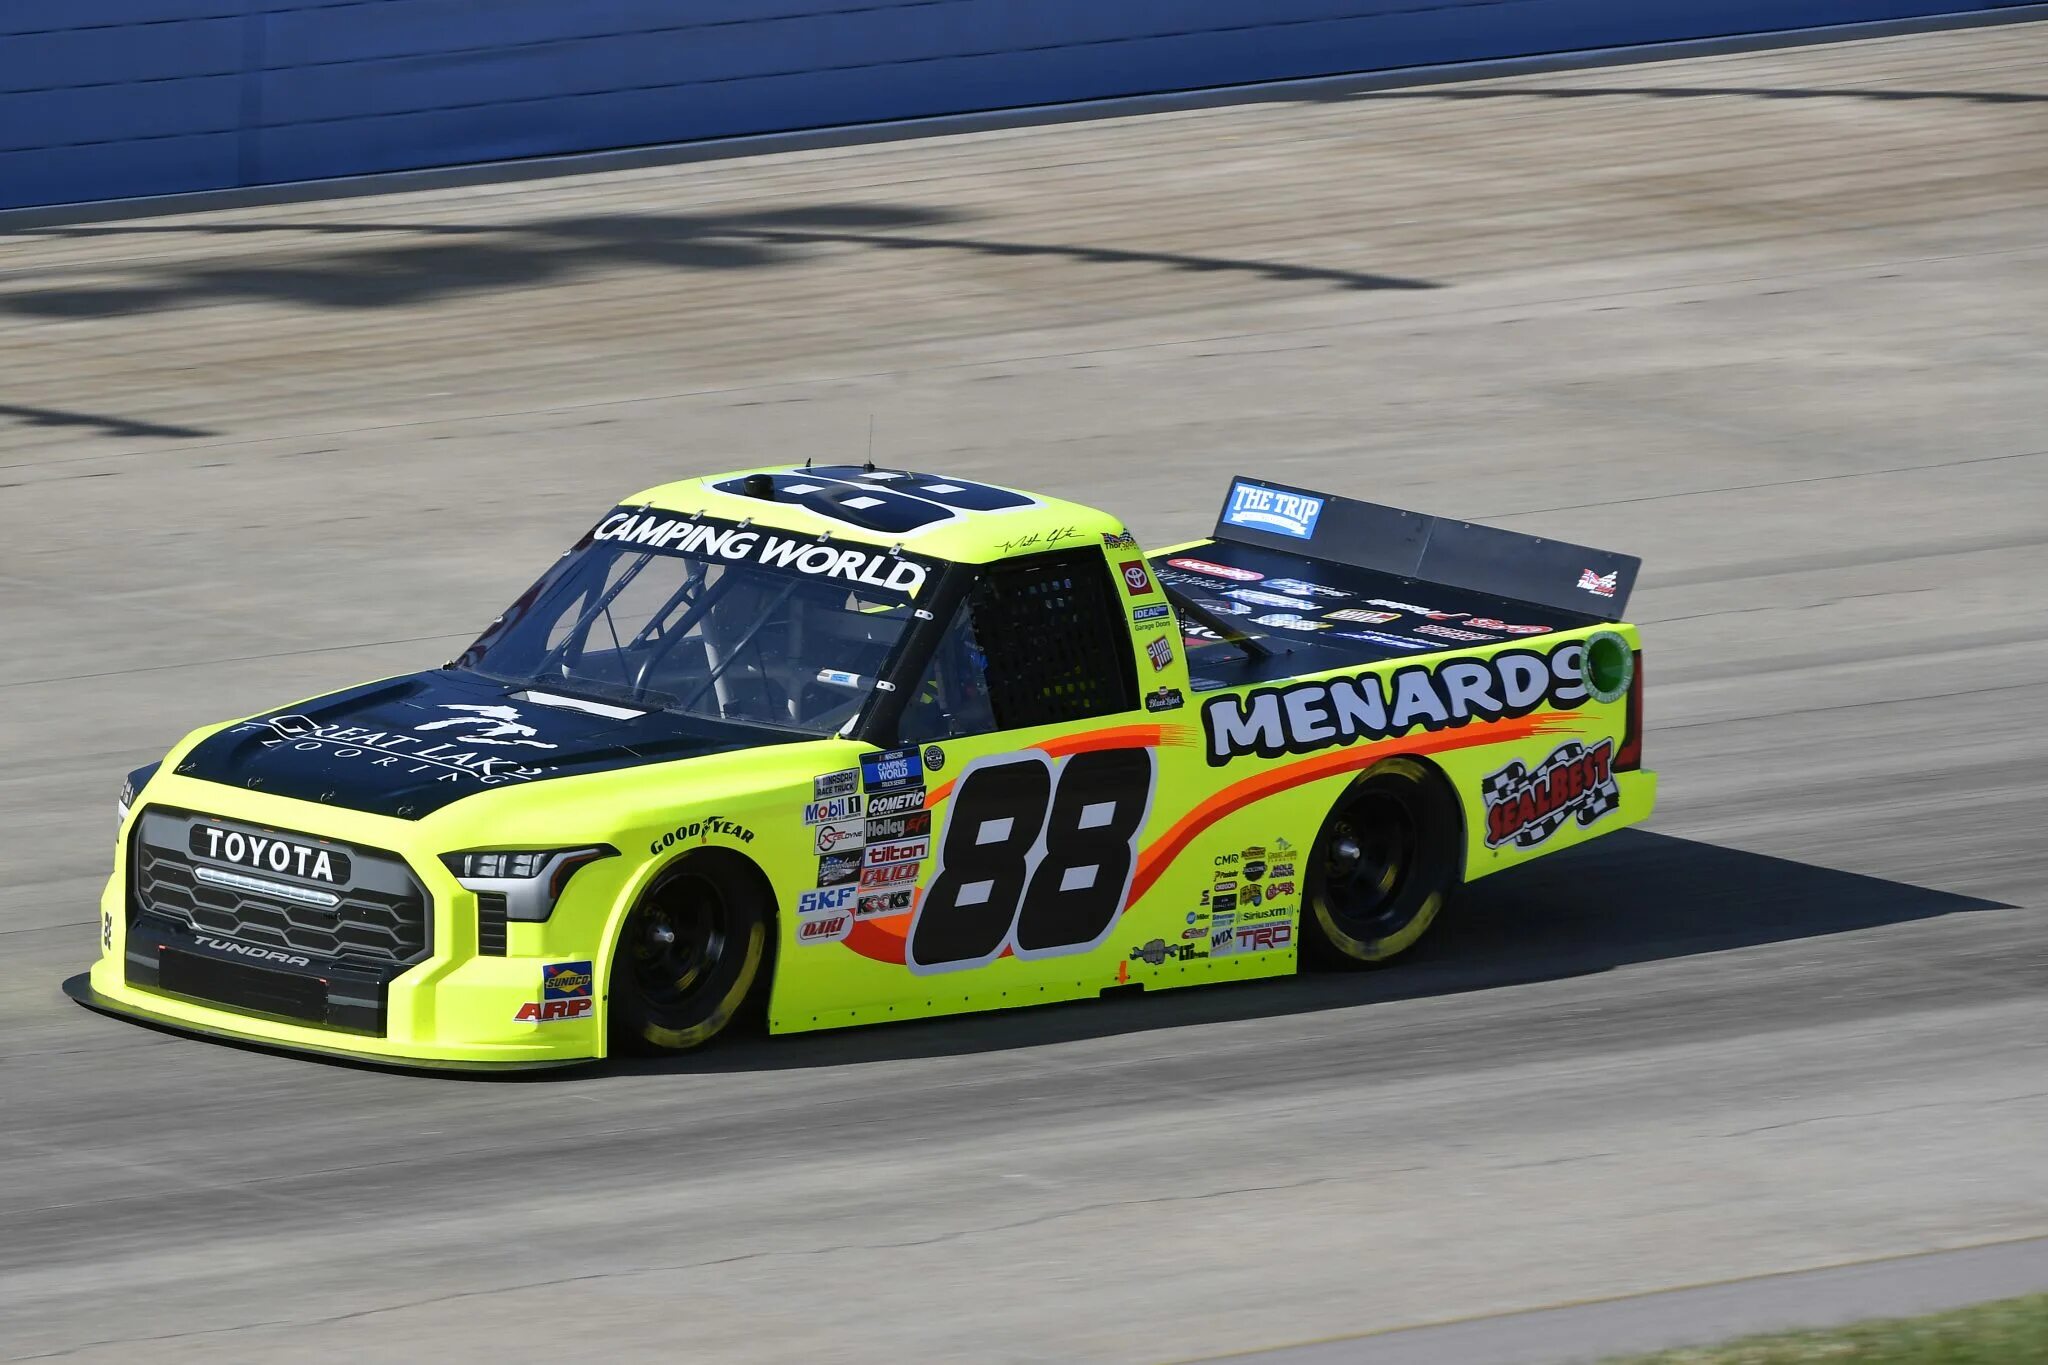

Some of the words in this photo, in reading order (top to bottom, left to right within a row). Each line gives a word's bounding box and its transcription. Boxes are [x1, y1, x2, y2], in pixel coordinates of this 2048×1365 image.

[1233, 486, 1274, 511] THE
[1274, 494, 1319, 524] TRIP
[593, 513, 759, 559] CAMPING
[758, 537, 928, 592] WORLD
[1134, 607, 1159, 619] IDEAL
[1135, 623, 1155, 631] Garage
[1149, 637, 1169, 658] slim
[1156, 649, 1172, 670] jim
[1206, 643, 1592, 760] MENARDS
[877, 759, 907, 771] CAMPING
[884, 752, 904, 760] NASCAR
[828, 772, 853, 785] NASCAR
[879, 768, 908, 780] WORLD
[817, 785, 832, 796] RACE
[834, 783, 854, 794] TRUCK
[1487, 744, 1613, 844] SEALBEST
[805, 798, 845, 820] Mobil
[868, 791, 925, 813] COMETIC
[867, 819, 905, 837] Holley
[206, 828, 334, 882] TOYOTA
[868, 843, 926, 864] tilton
[908, 745, 1156, 972] 88
[862, 862, 920, 887] CALICO
[799, 886, 857, 912] SKF
[857, 889, 912, 915] KOOKS
[1211, 927, 1233, 947] WIX
[1236, 926, 1292, 951] TRD
[195, 935, 310, 967] TUNDRA
[547, 975, 590, 988] SUNOCO
[514, 998, 592, 1020] ARP
